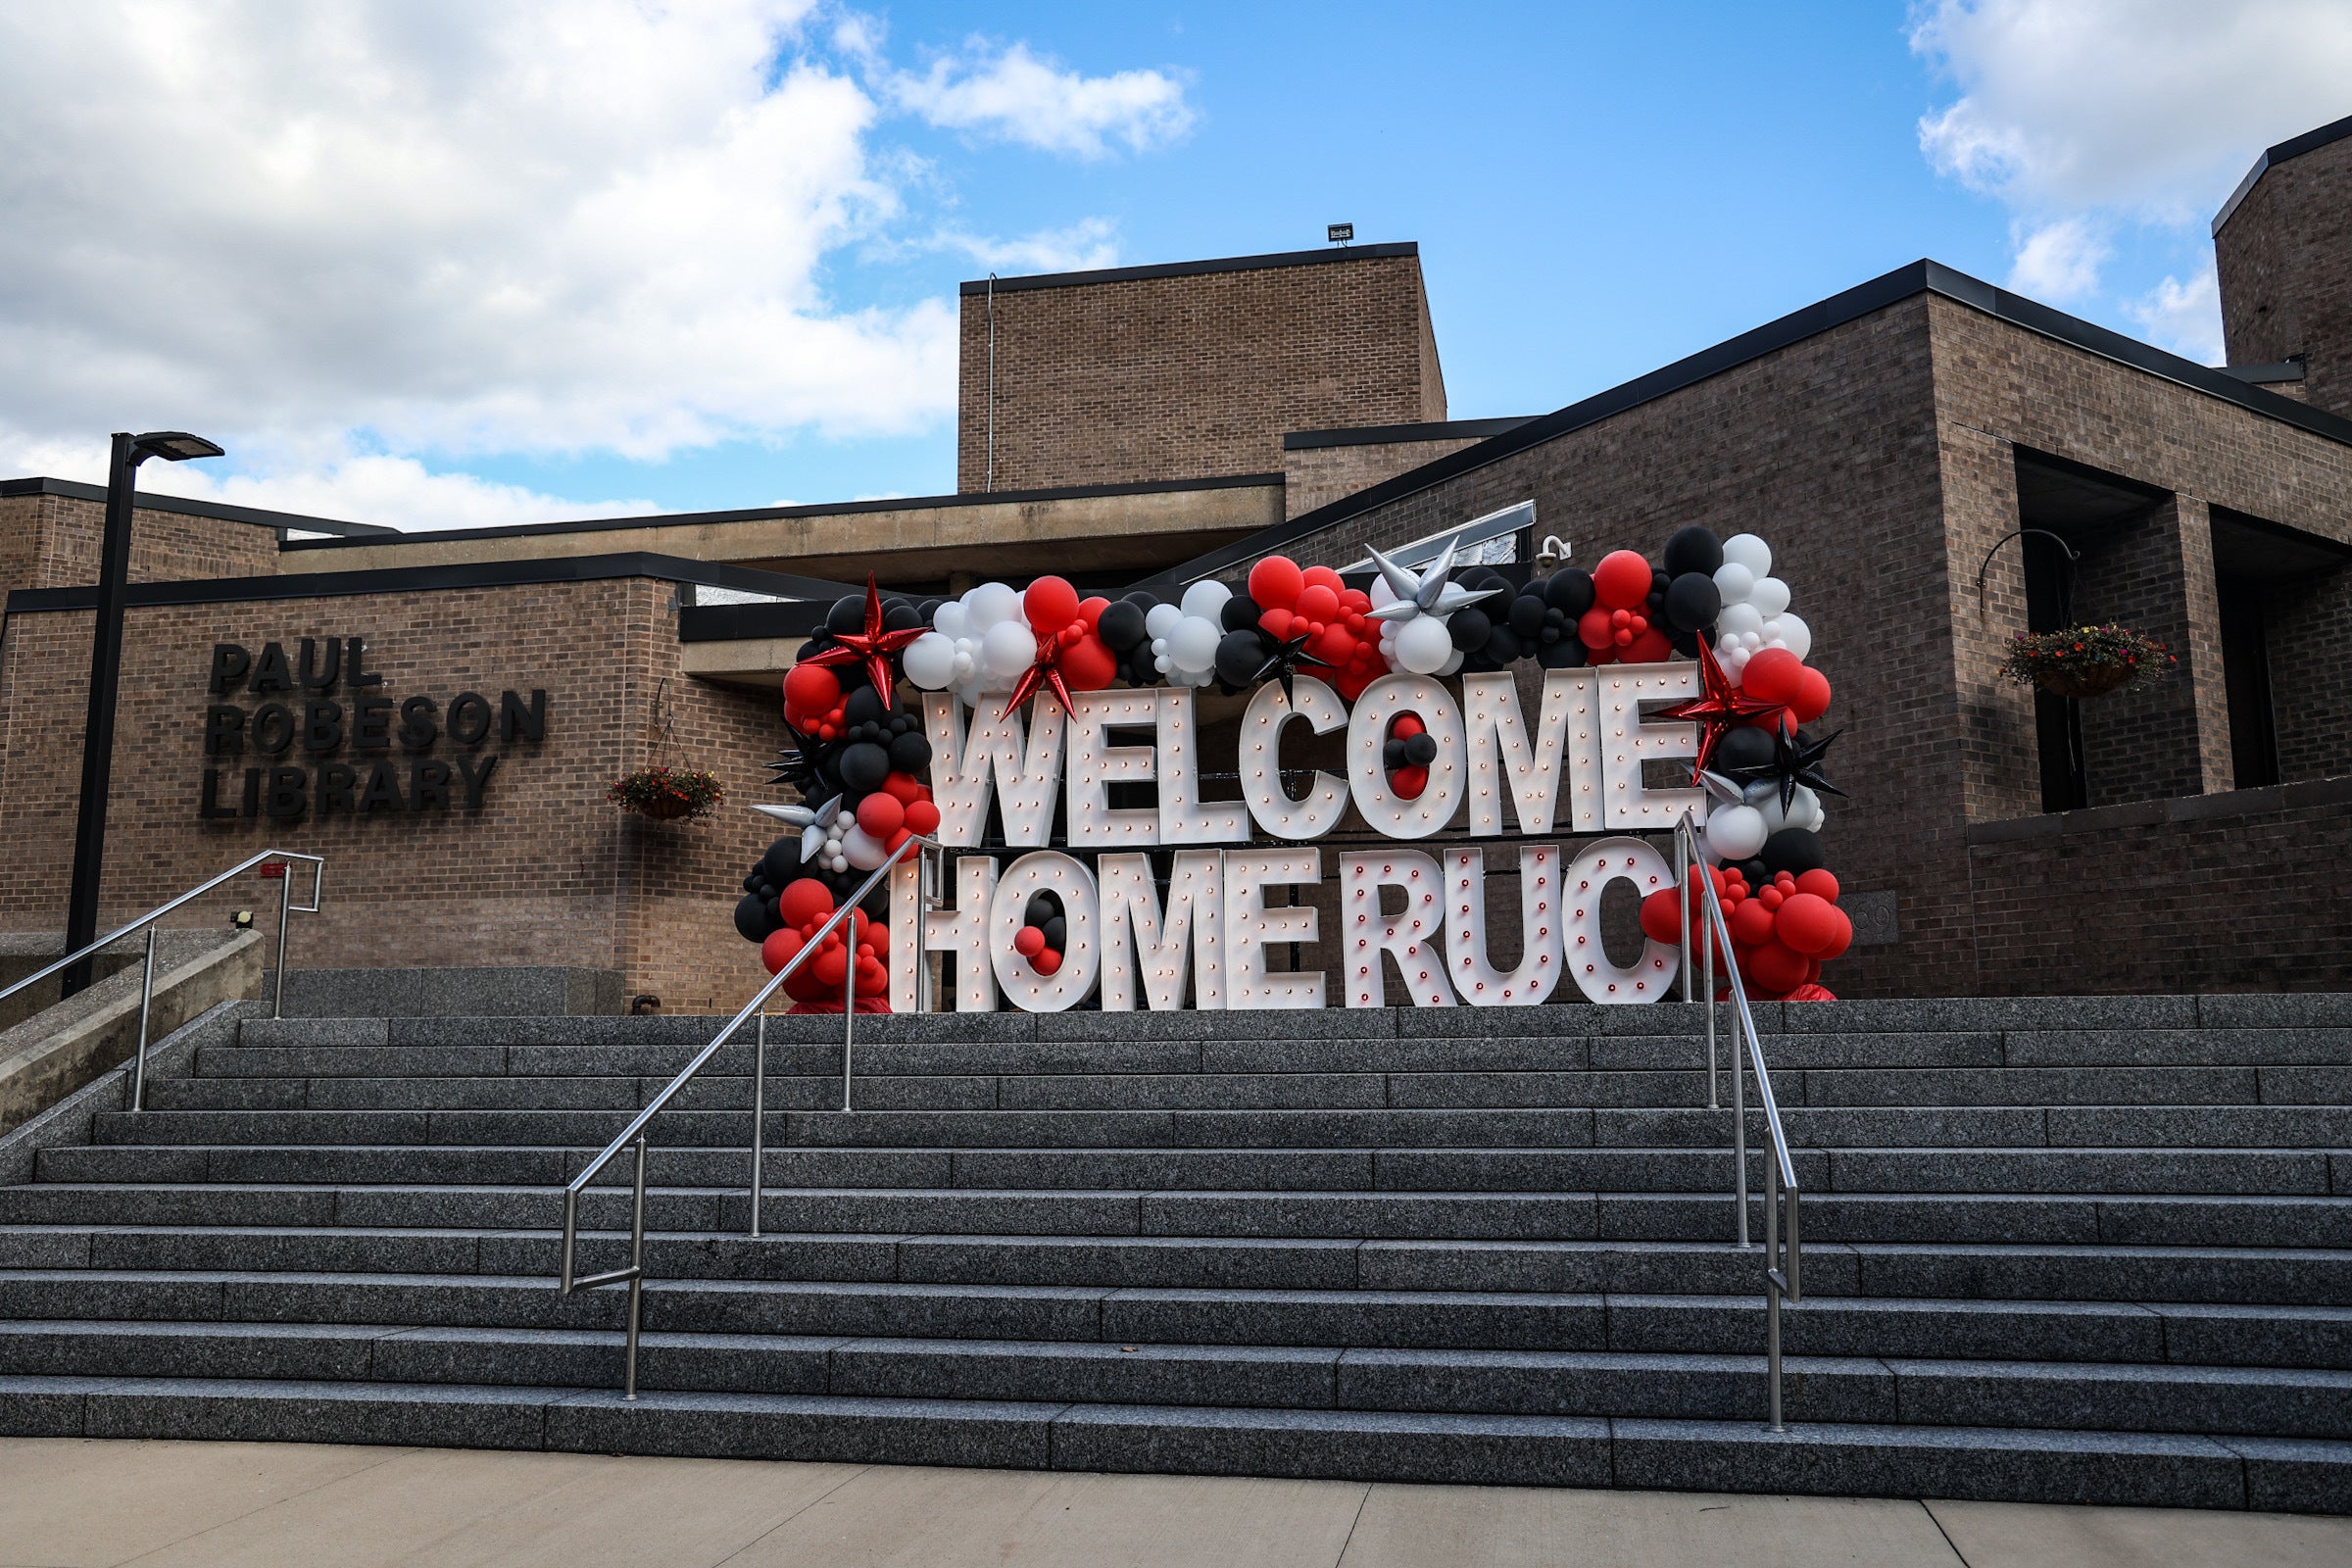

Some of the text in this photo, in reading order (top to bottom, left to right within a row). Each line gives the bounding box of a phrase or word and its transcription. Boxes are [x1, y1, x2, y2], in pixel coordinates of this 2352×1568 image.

[208, 637, 382, 693] PAUL
[204, 689, 546, 755] ROBESON
[922, 661, 1707, 847] WELCOME
[200, 756, 498, 818] LIBRARY
[889, 836, 1681, 1012] HOME RUC
